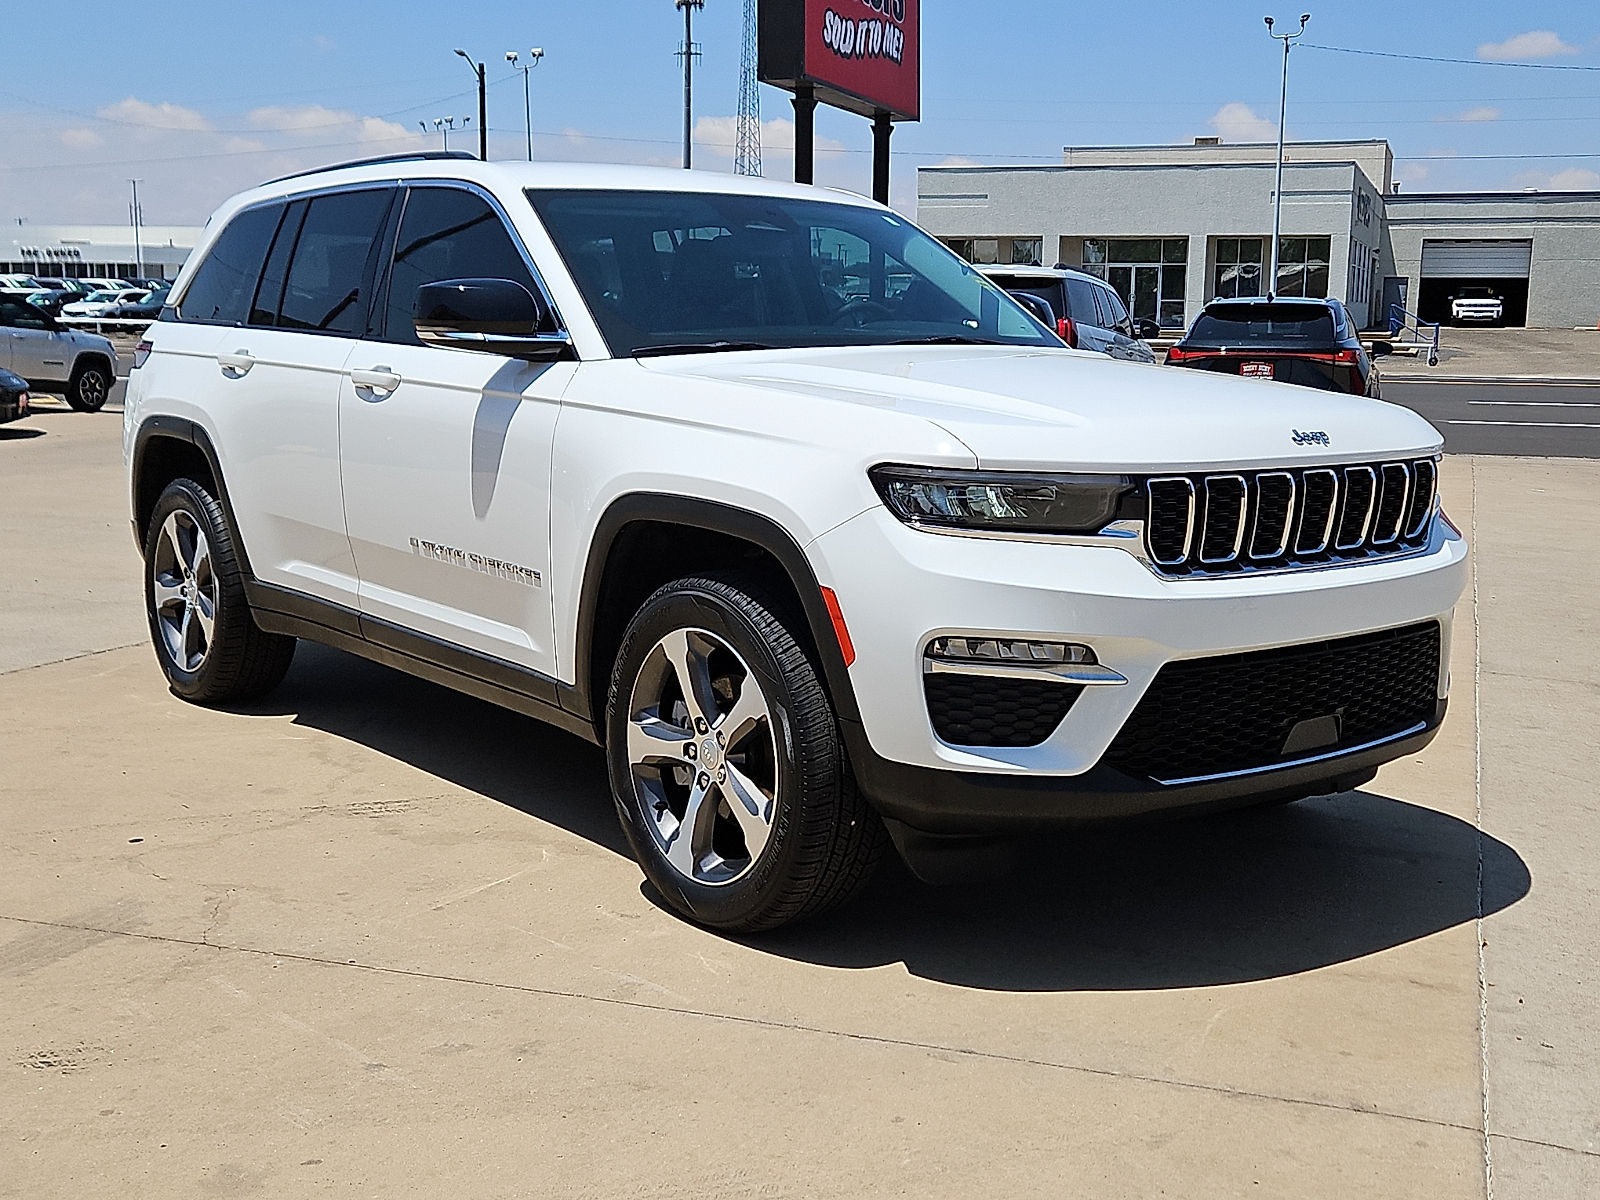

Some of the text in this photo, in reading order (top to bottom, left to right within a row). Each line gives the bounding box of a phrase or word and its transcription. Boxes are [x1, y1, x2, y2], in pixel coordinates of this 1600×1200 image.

[823, 9, 855, 56] SOLD
[855, 19, 868, 57] IT
[868, 19, 882, 56] TO
[882, 20, 904, 64] ME!
[1291, 429, 1330, 447] Jeep
